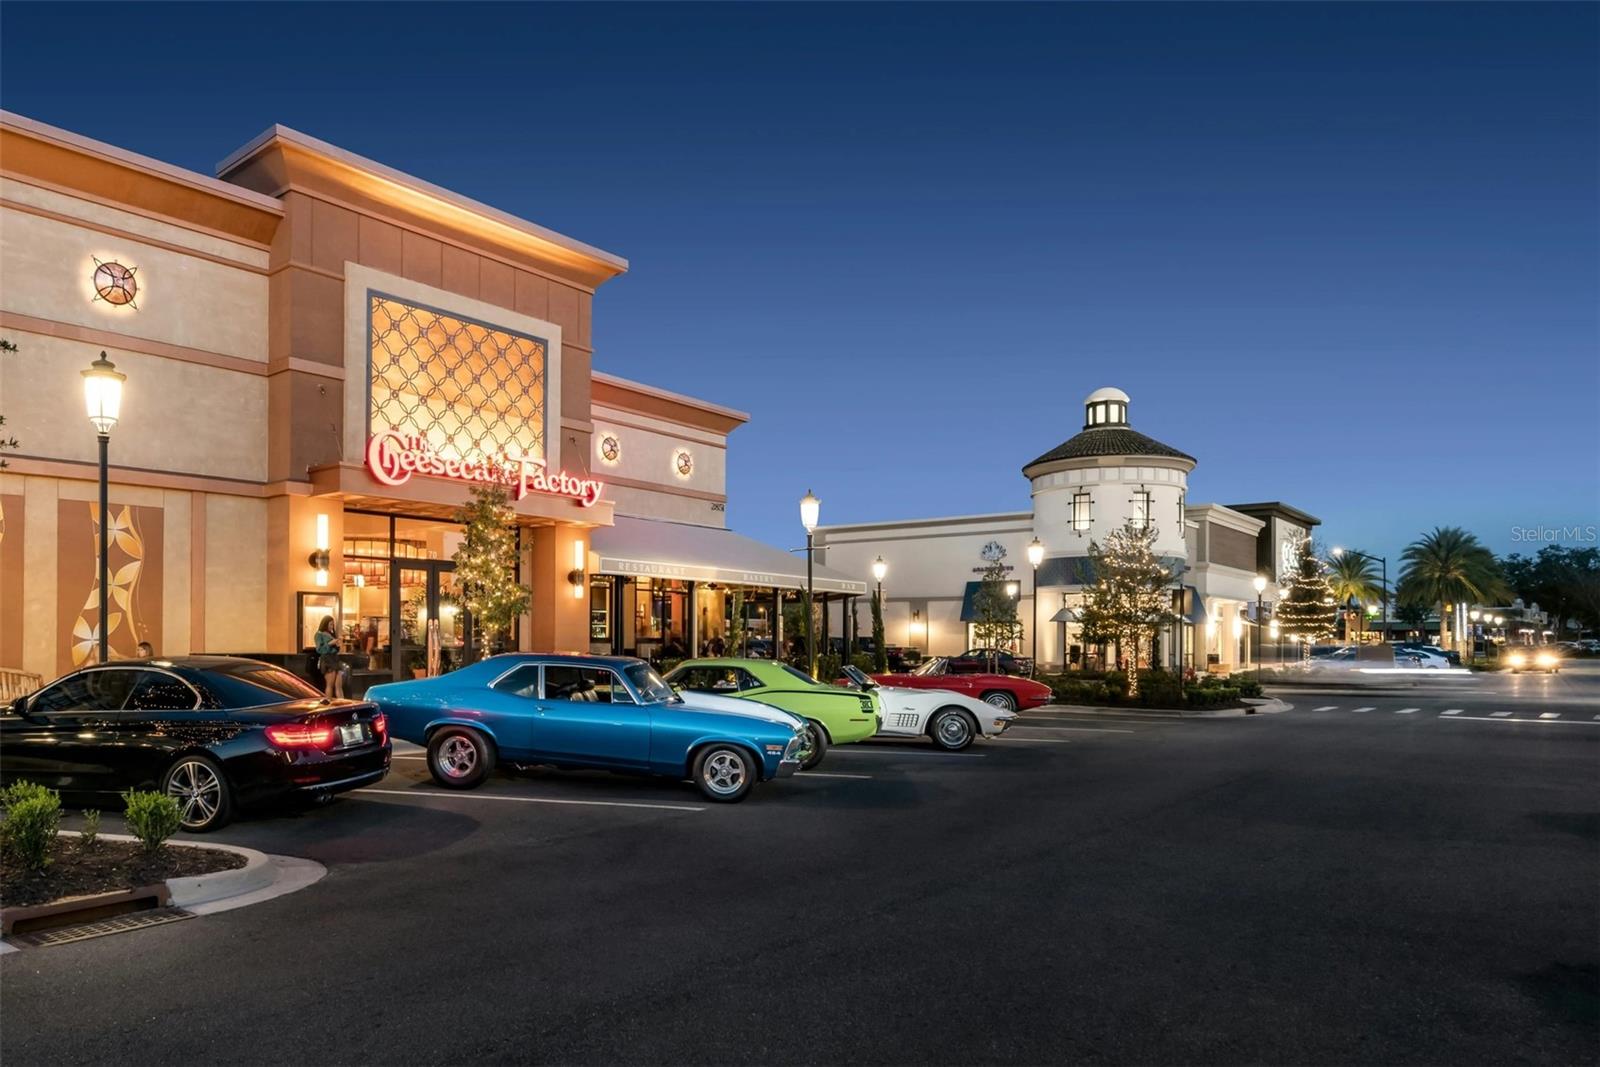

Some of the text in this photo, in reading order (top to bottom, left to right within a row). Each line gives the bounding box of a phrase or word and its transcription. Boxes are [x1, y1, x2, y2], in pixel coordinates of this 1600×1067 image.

[507, 455, 604, 508] Factory
[618, 562, 857, 590] RESTAURANT BAKERY BAR
